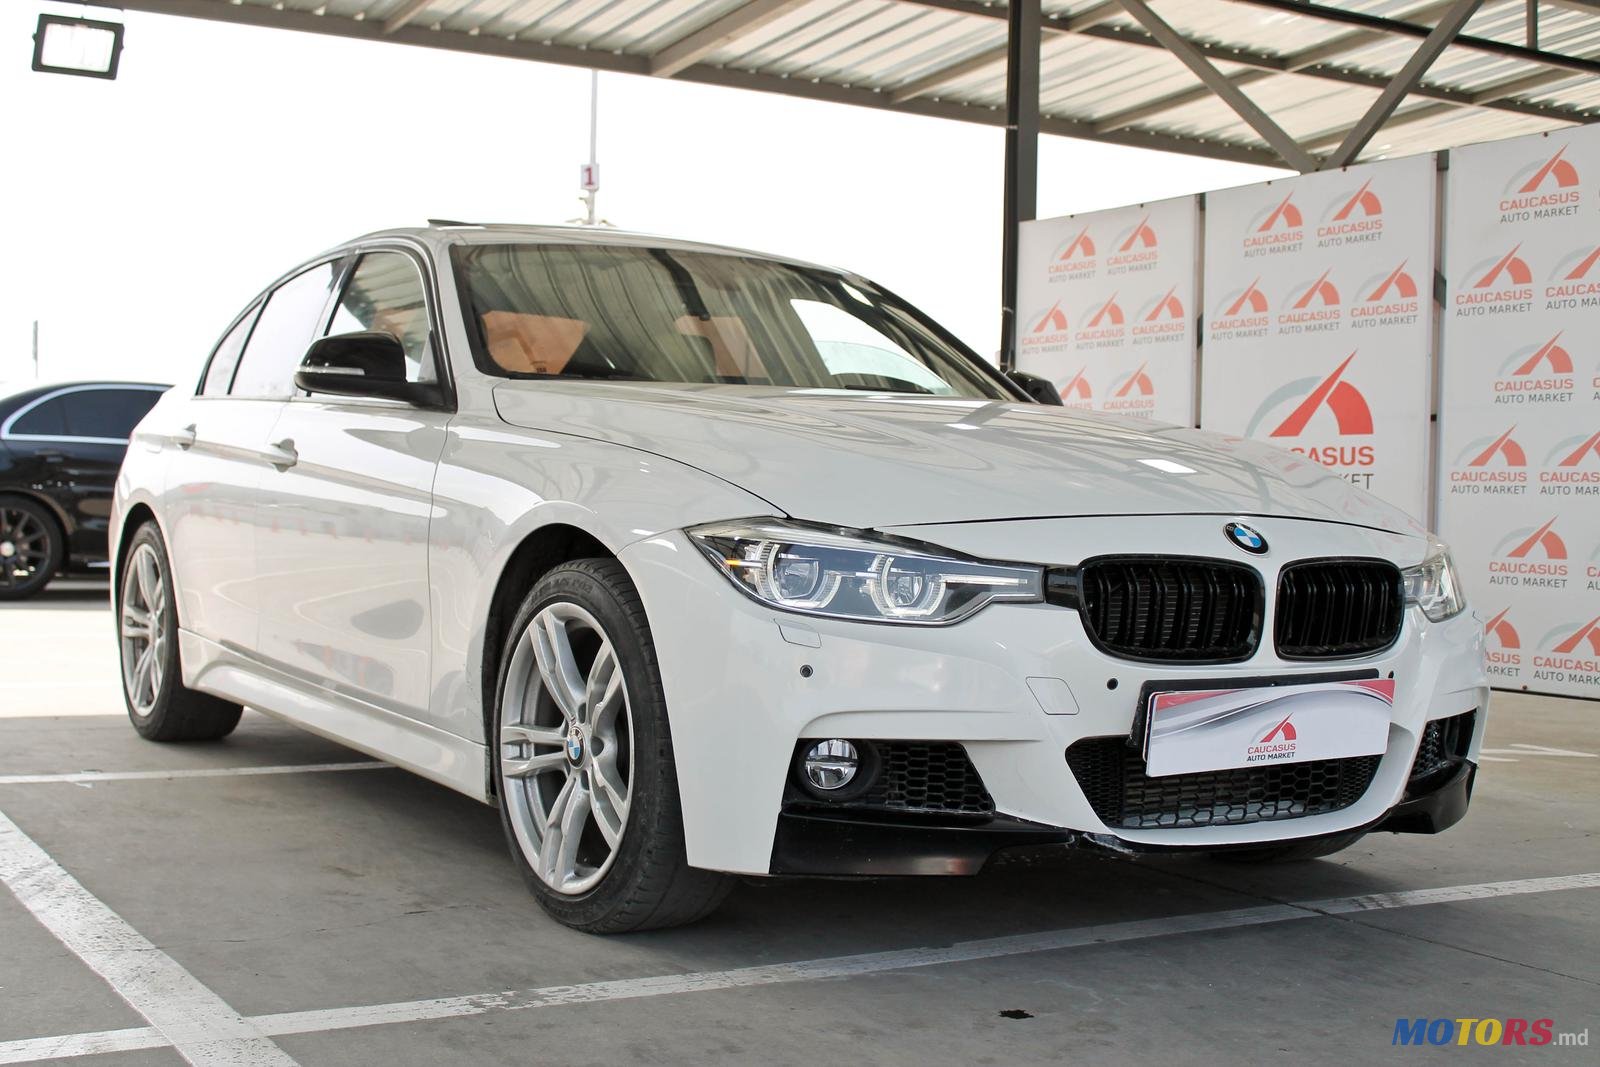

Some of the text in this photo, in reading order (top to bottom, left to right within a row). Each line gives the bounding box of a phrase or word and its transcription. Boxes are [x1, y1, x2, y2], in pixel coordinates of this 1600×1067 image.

[584, 167, 595, 186] 1
[1500, 191, 1580, 212] CAUCASUS
[1500, 205, 1579, 224] AUTO MARKET
[1317, 219, 1383, 238] CAUCASUS
[1243, 230, 1304, 248] CAUCASUS
[1317, 232, 1383, 248] AUTO MARKET
[1243, 243, 1303, 258] AUTO MARKET
[1107, 252, 1158, 267] CAUCASUS
[1048, 260, 1096, 274] CAUCASUS
[1456, 289, 1533, 305] CAUCASUS
[1351, 302, 1418, 318] CAUCASUS
[1456, 303, 1533, 317] AUTO MARKET
[1545, 299, 1577, 310] AUTO
[1211, 317, 1269, 331] CAUCASUS
[1278, 310, 1340, 324] CAUCASUS
[1351, 315, 1418, 329] AUTO MARKET
[1075, 328, 1125, 342] CAUCASUS
[1132, 324, 1185, 336] CAUCASUS
[1211, 328, 1268, 341] AUTO MARKET
[1278, 322, 1340, 335] AUTO MARKET
[1494, 378, 1574, 392] CAUCASUS
[1495, 392, 1573, 404] AUTO MARKET
[1450, 471, 1527, 482] CAUCASUS
[1451, 485, 1527, 495] AUTO MARKET
[1540, 486, 1571, 495] AUTO
[1489, 562, 1568, 575] CAUCASUS
[1489, 576, 1567, 588] AUTO MARKET
[1533, 670, 1564, 681] AUTO
[1247, 743, 1296, 755] CAUCASUS
[1268, 752, 1295, 760] MARKET
